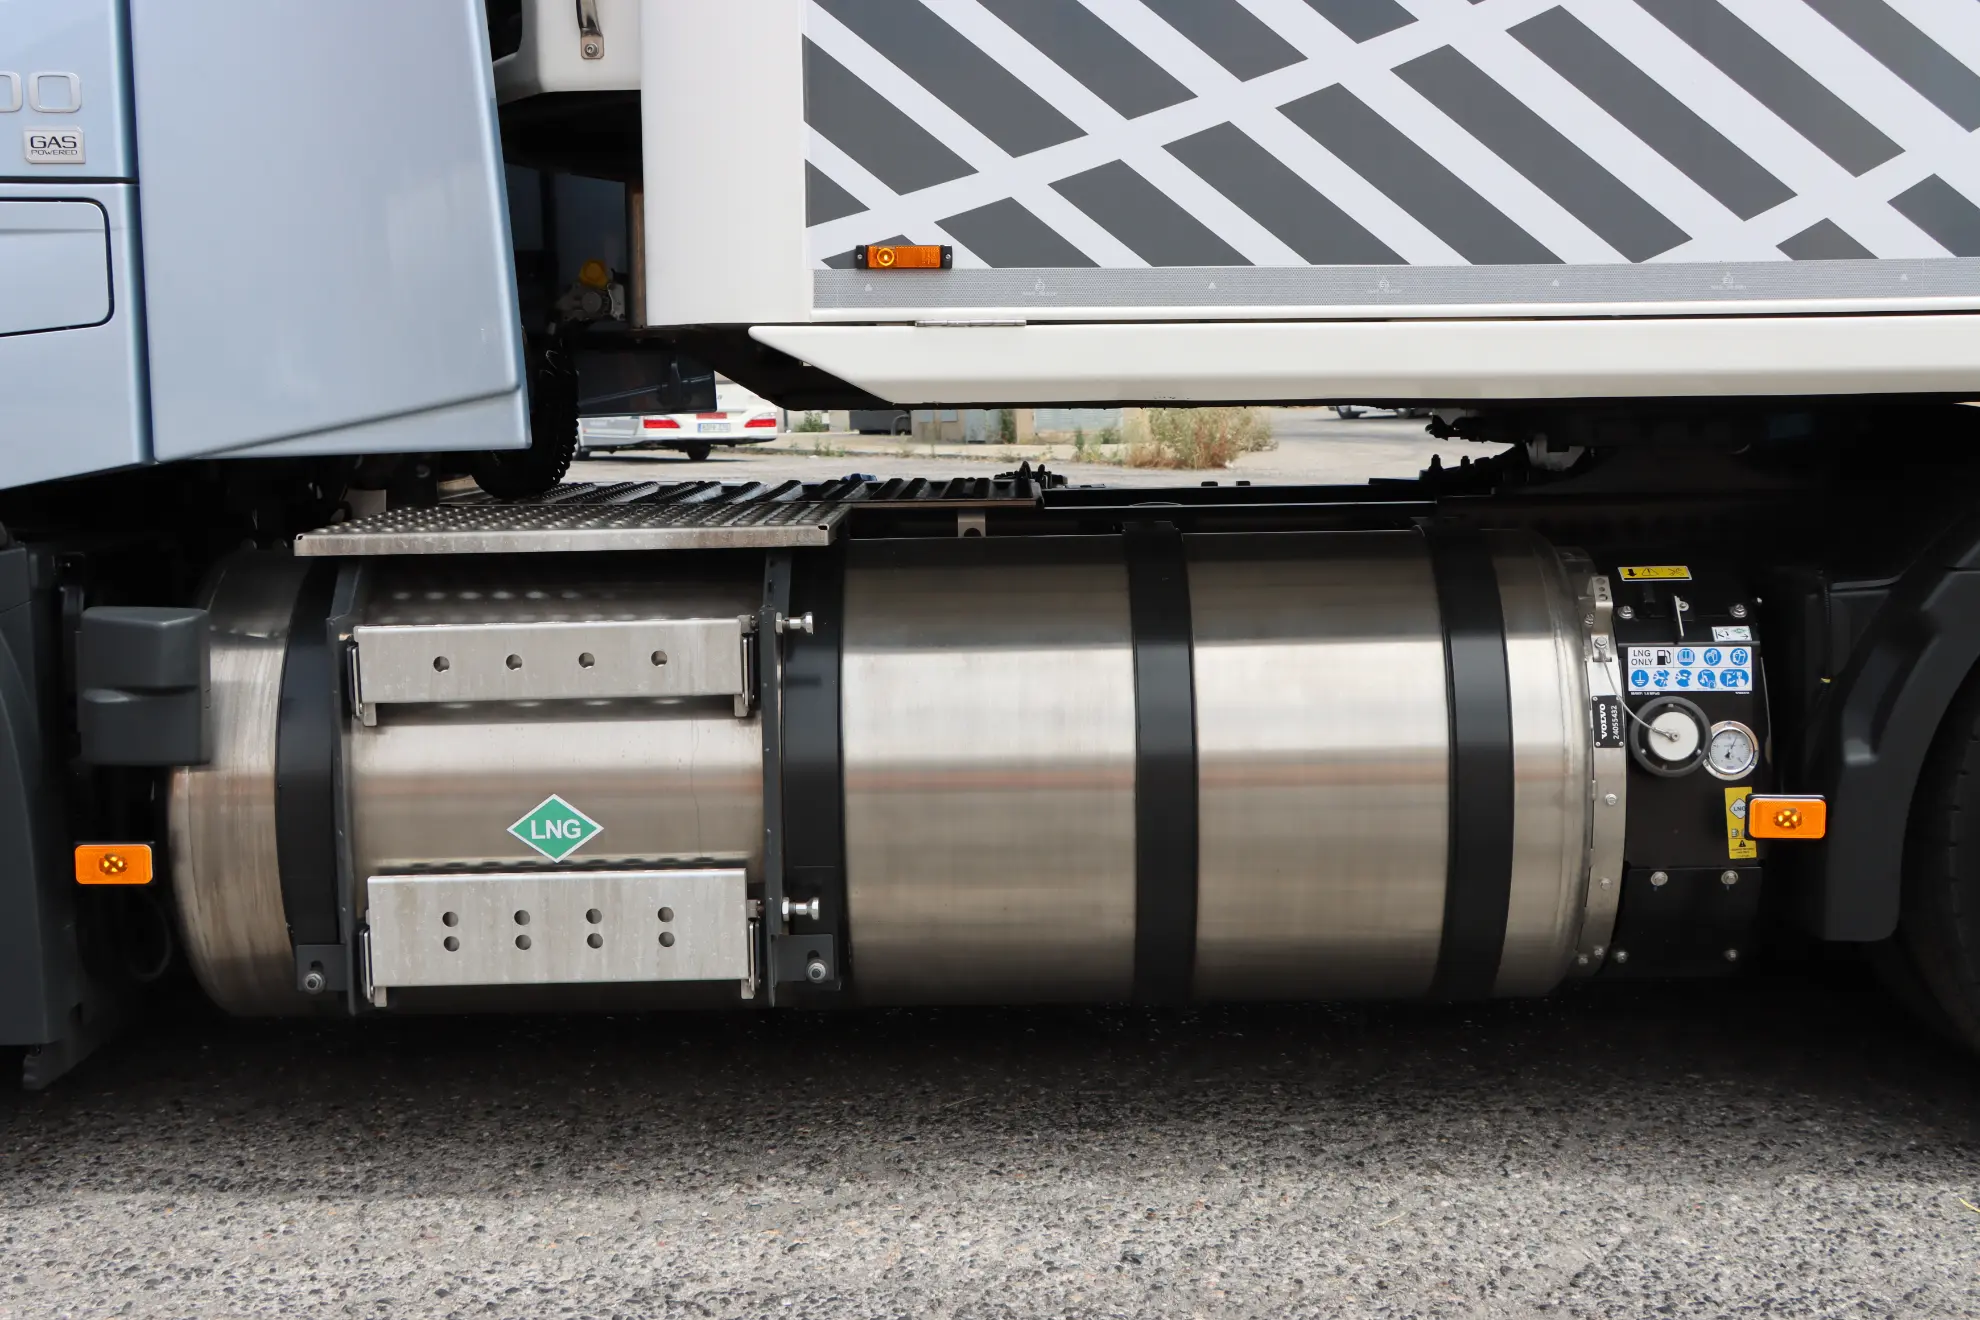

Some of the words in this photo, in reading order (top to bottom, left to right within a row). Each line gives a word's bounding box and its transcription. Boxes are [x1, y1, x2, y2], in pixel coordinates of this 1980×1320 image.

[30, 135, 77, 149] GAS
[1631, 658, 1654, 666] ONLY
[1600, 703, 1608, 740] VOLVO
[1611, 704, 1620, 740] 24055432
[530, 818, 582, 840] LNG
